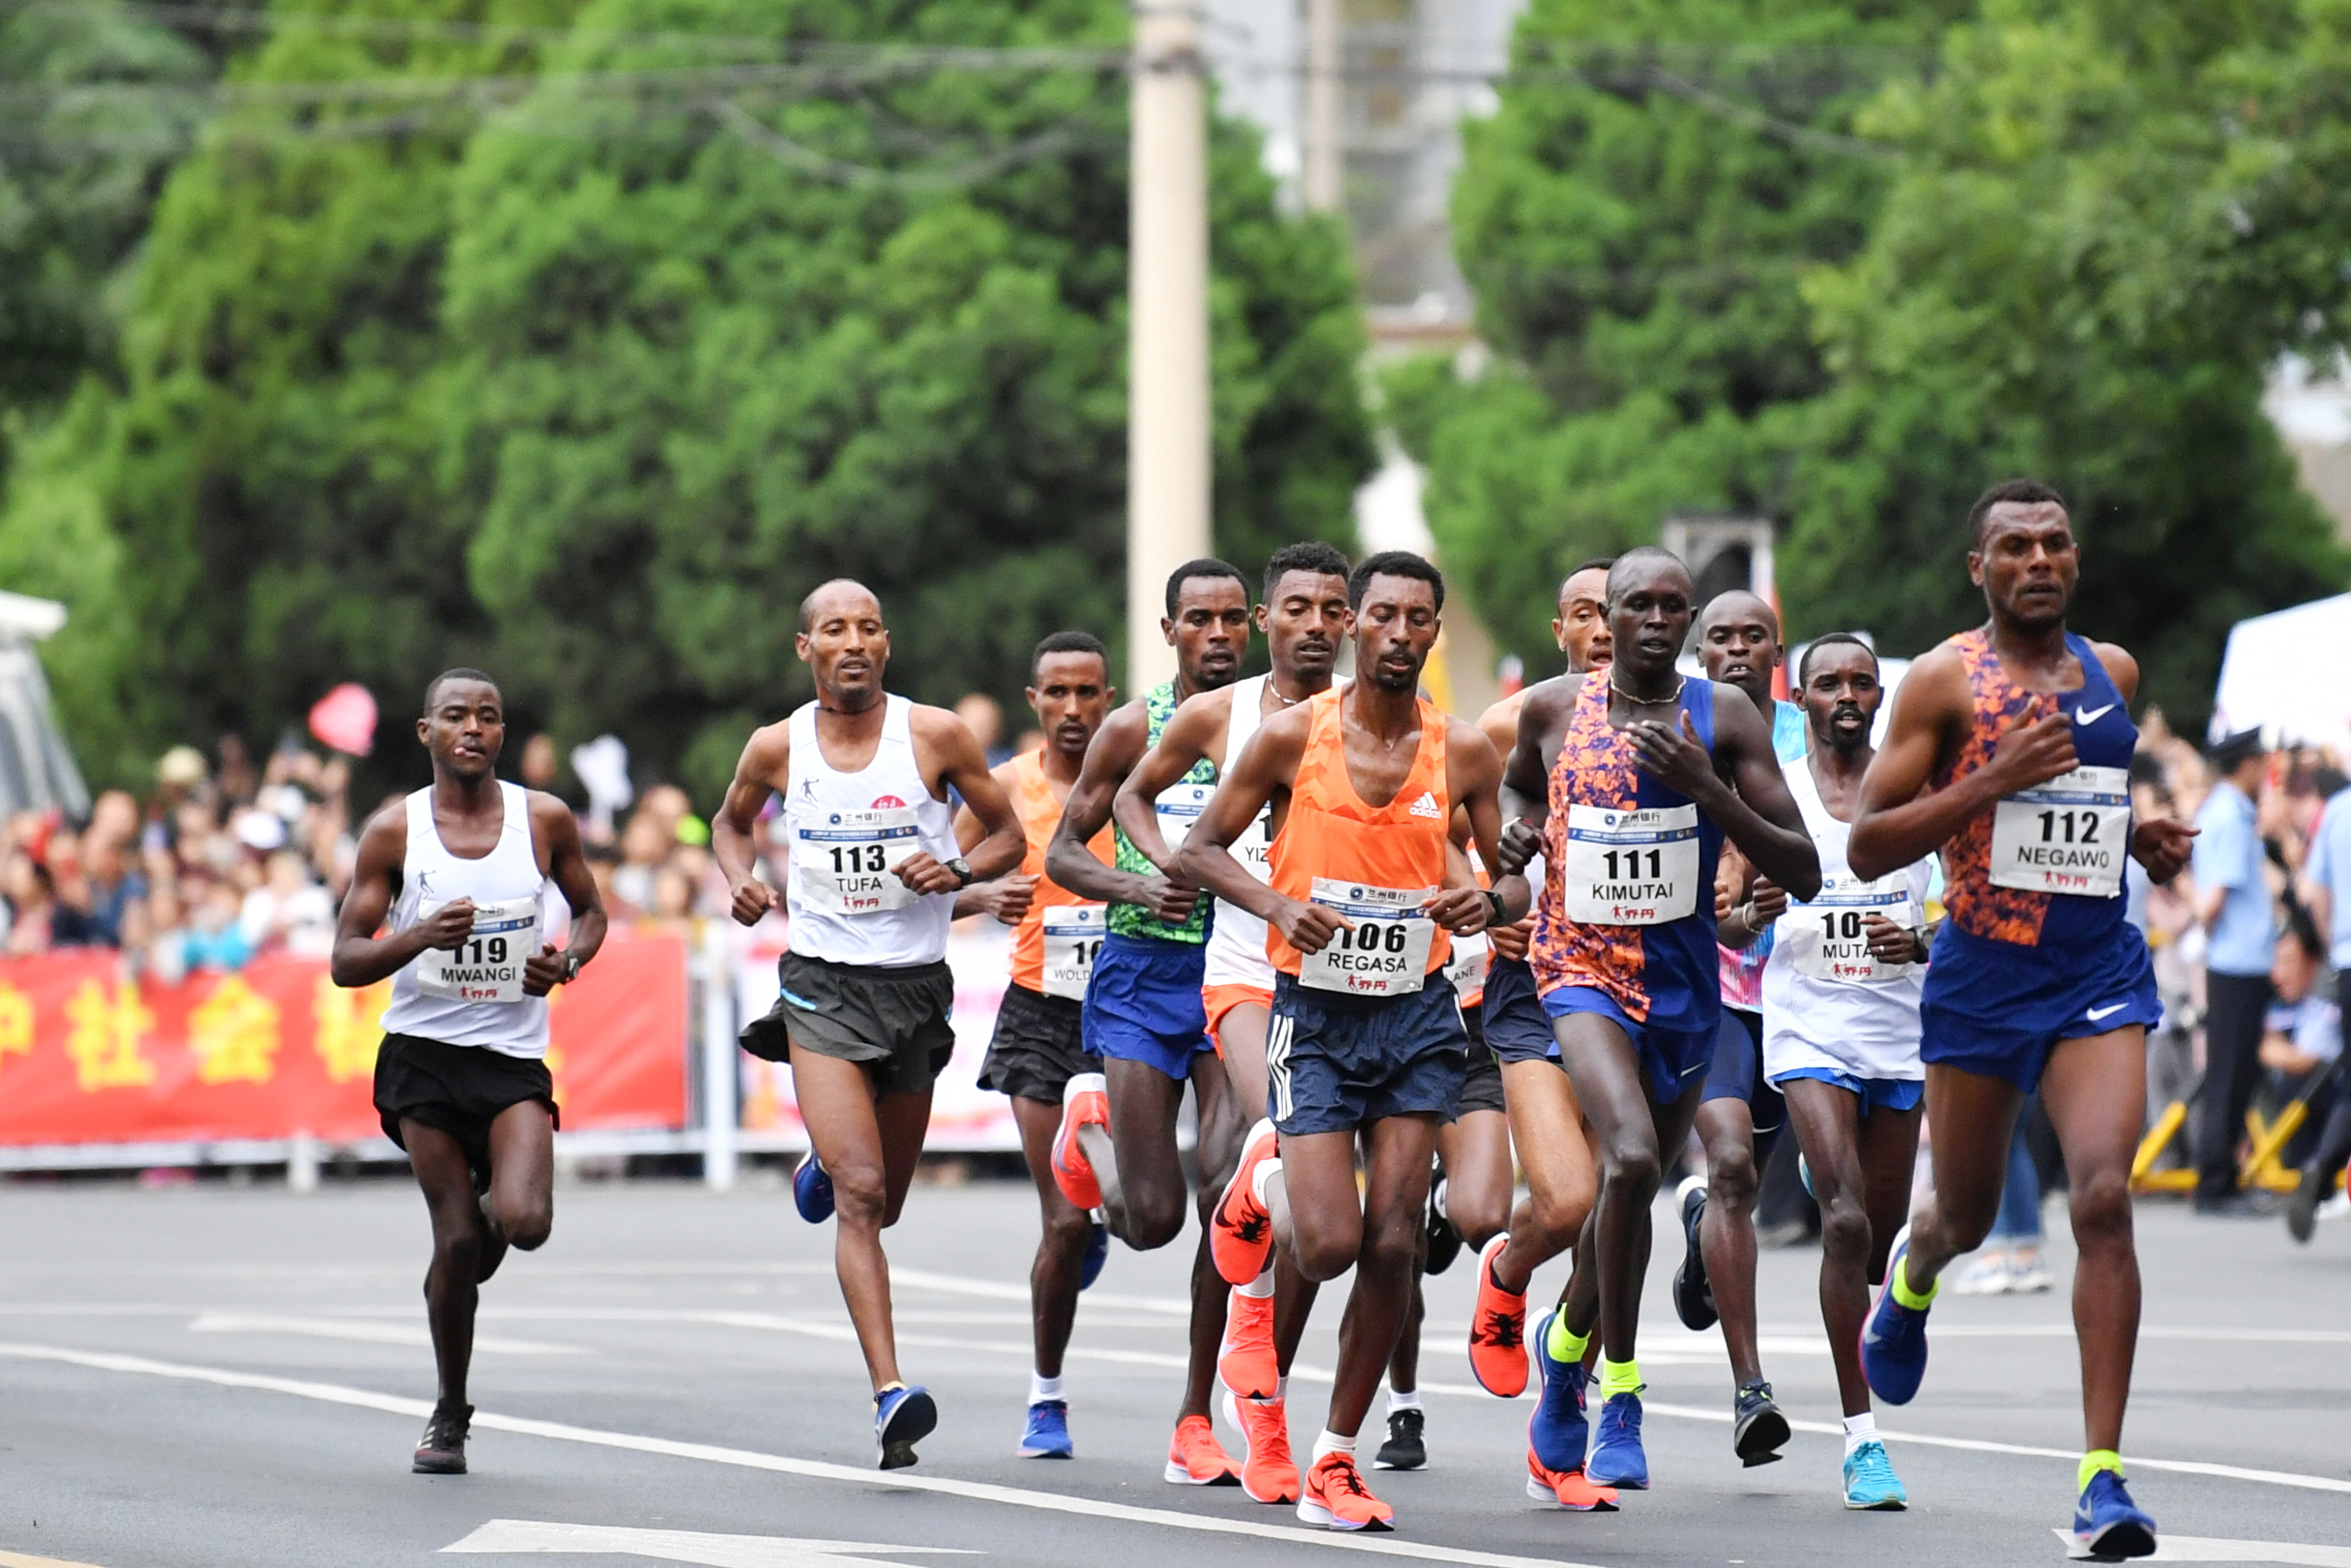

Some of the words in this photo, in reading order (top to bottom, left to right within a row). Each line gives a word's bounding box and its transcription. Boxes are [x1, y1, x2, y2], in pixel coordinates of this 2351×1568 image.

[1409, 807, 1442, 819] adidas
[2037, 810, 2099, 844] 112
[830, 845, 886, 873] 113
[1603, 849, 1661, 879] 111
[2017, 846, 2110, 868] NEGAWO
[836, 877, 883, 892] TUFA
[1592, 883, 1673, 901] KIMUTAI
[1341, 923, 1406, 953] 106
[453, 937, 507, 965] 119
[1327, 952, 1407, 972] REGASA
[442, 968, 516, 982] MWANGI
[1446, 965, 1476, 982] ANE
